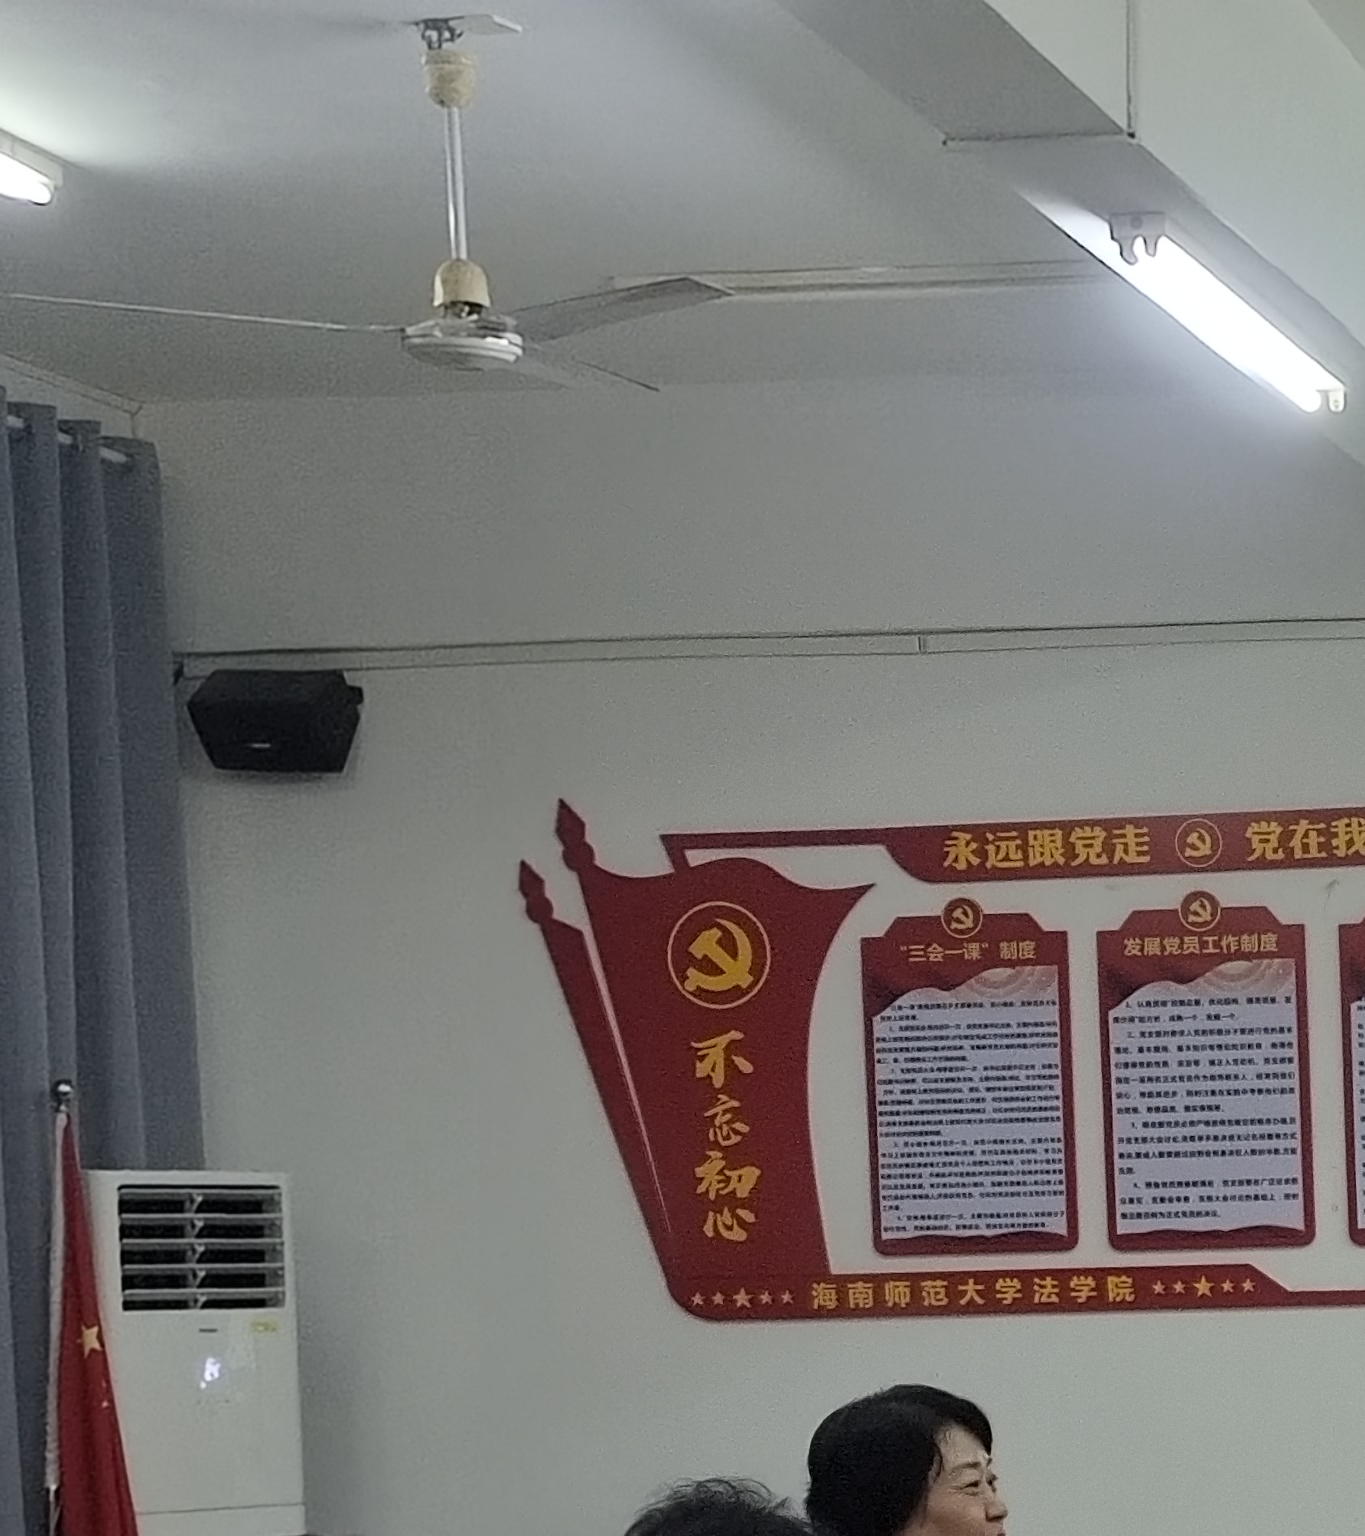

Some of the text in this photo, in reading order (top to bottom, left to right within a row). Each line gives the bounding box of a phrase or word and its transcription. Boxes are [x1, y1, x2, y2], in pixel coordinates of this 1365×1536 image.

[943, 824, 1151, 871] 永远跟党走
[1123, 933, 1279, 957] 发展党员工作制度
[691, 1030, 762, 1242] 不忘初心
[811, 1275, 1136, 1310] 海南师范大学法学院
